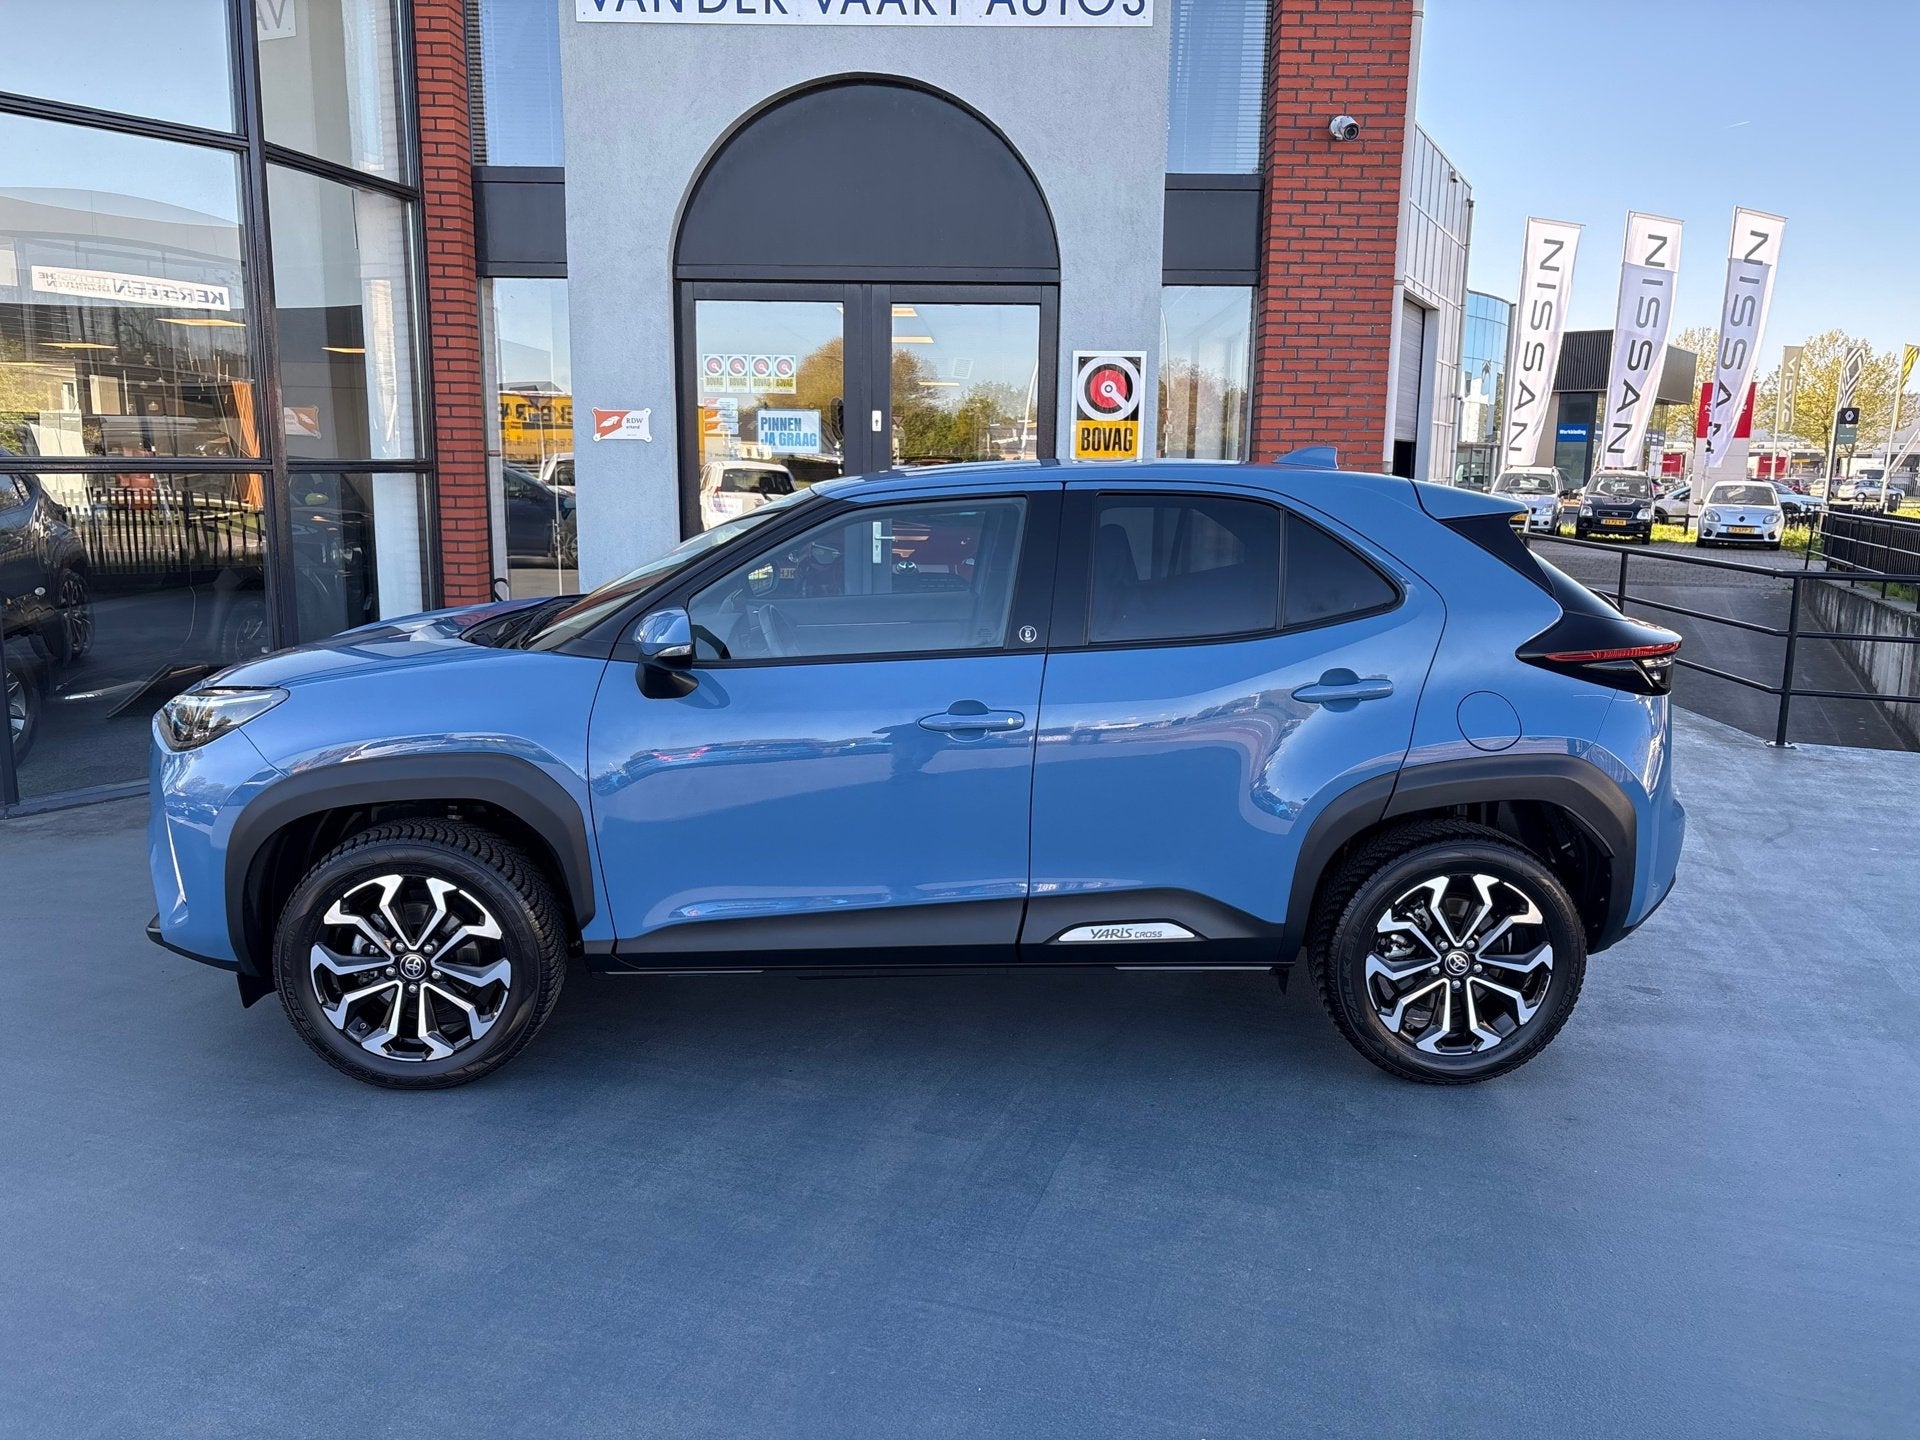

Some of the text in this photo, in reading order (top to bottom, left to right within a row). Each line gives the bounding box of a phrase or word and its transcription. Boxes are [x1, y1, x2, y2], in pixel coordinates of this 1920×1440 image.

[1508, 238, 1564, 451] NISSAN
[1606, 234, 1668, 453] NISSAN
[761, 417, 801, 431] PINNEN
[761, 432, 817, 447] JA GRAAG
[1081, 427, 1133, 452] BOVAG
[1090, 928, 1162, 939] YARIS CROSS
